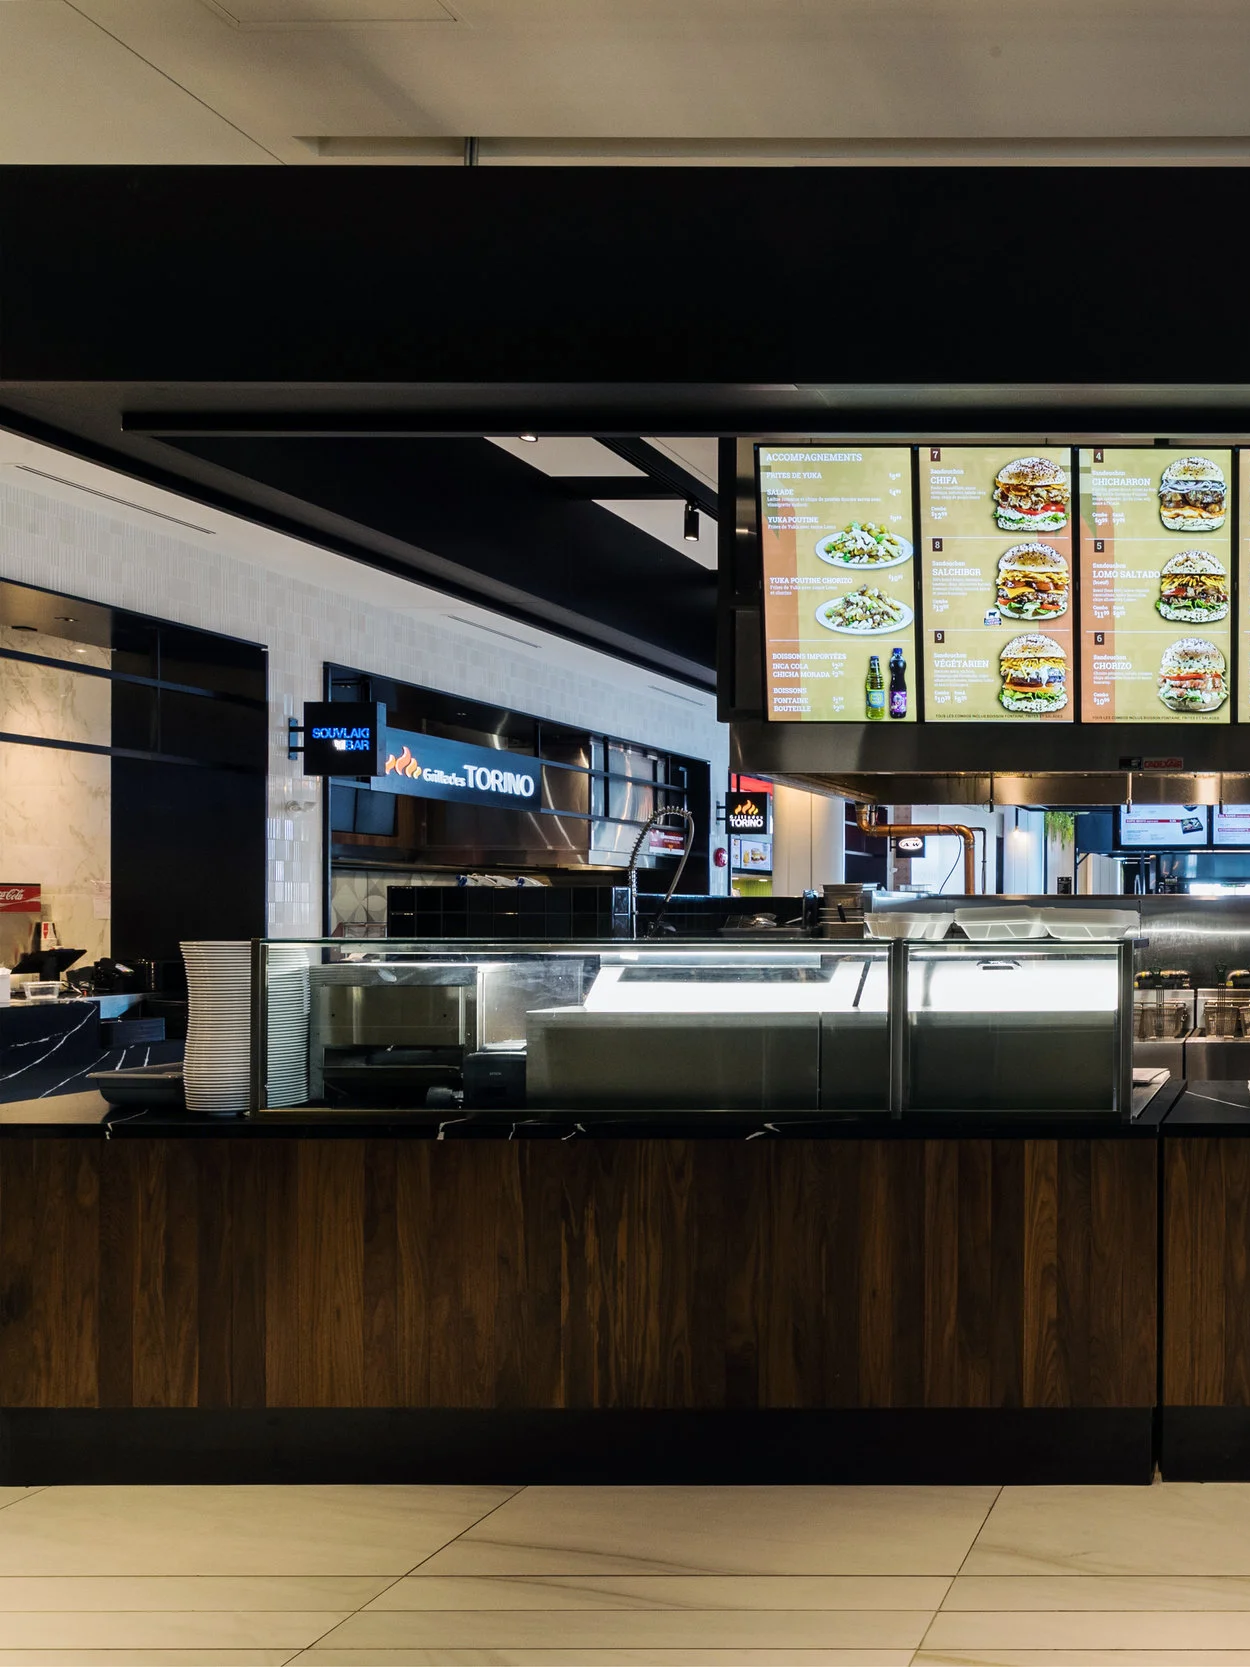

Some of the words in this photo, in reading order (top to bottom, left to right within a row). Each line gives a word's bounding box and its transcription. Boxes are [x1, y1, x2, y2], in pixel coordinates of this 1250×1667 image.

[766, 453, 863, 462] ACCOMPAGNEMENTS
[932, 451, 938, 459] 7
[1095, 452, 1101, 460] 4
[930, 476, 958, 484] CHIFA
[1092, 478, 1151, 486] CHICHARRON
[935, 541, 940, 549] 8
[1096, 542, 1102, 550] 5
[932, 568, 981, 576] SALCHIBGR
[1093, 570, 1119, 578] LOMO
[1119, 570, 1161, 578] SALTADO
[807, 652, 847, 660] IMPORTÉES
[934, 659, 989, 668] VÉGÉTARIEN
[1093, 662, 1132, 670] CHORIZO
[312, 727, 370, 739] SOUVLAKI
[345, 739, 370, 750] BAR
[422, 768, 467, 788] Grillades
[463, 764, 535, 797] TORINO
[730, 819, 764, 827] TORINO
